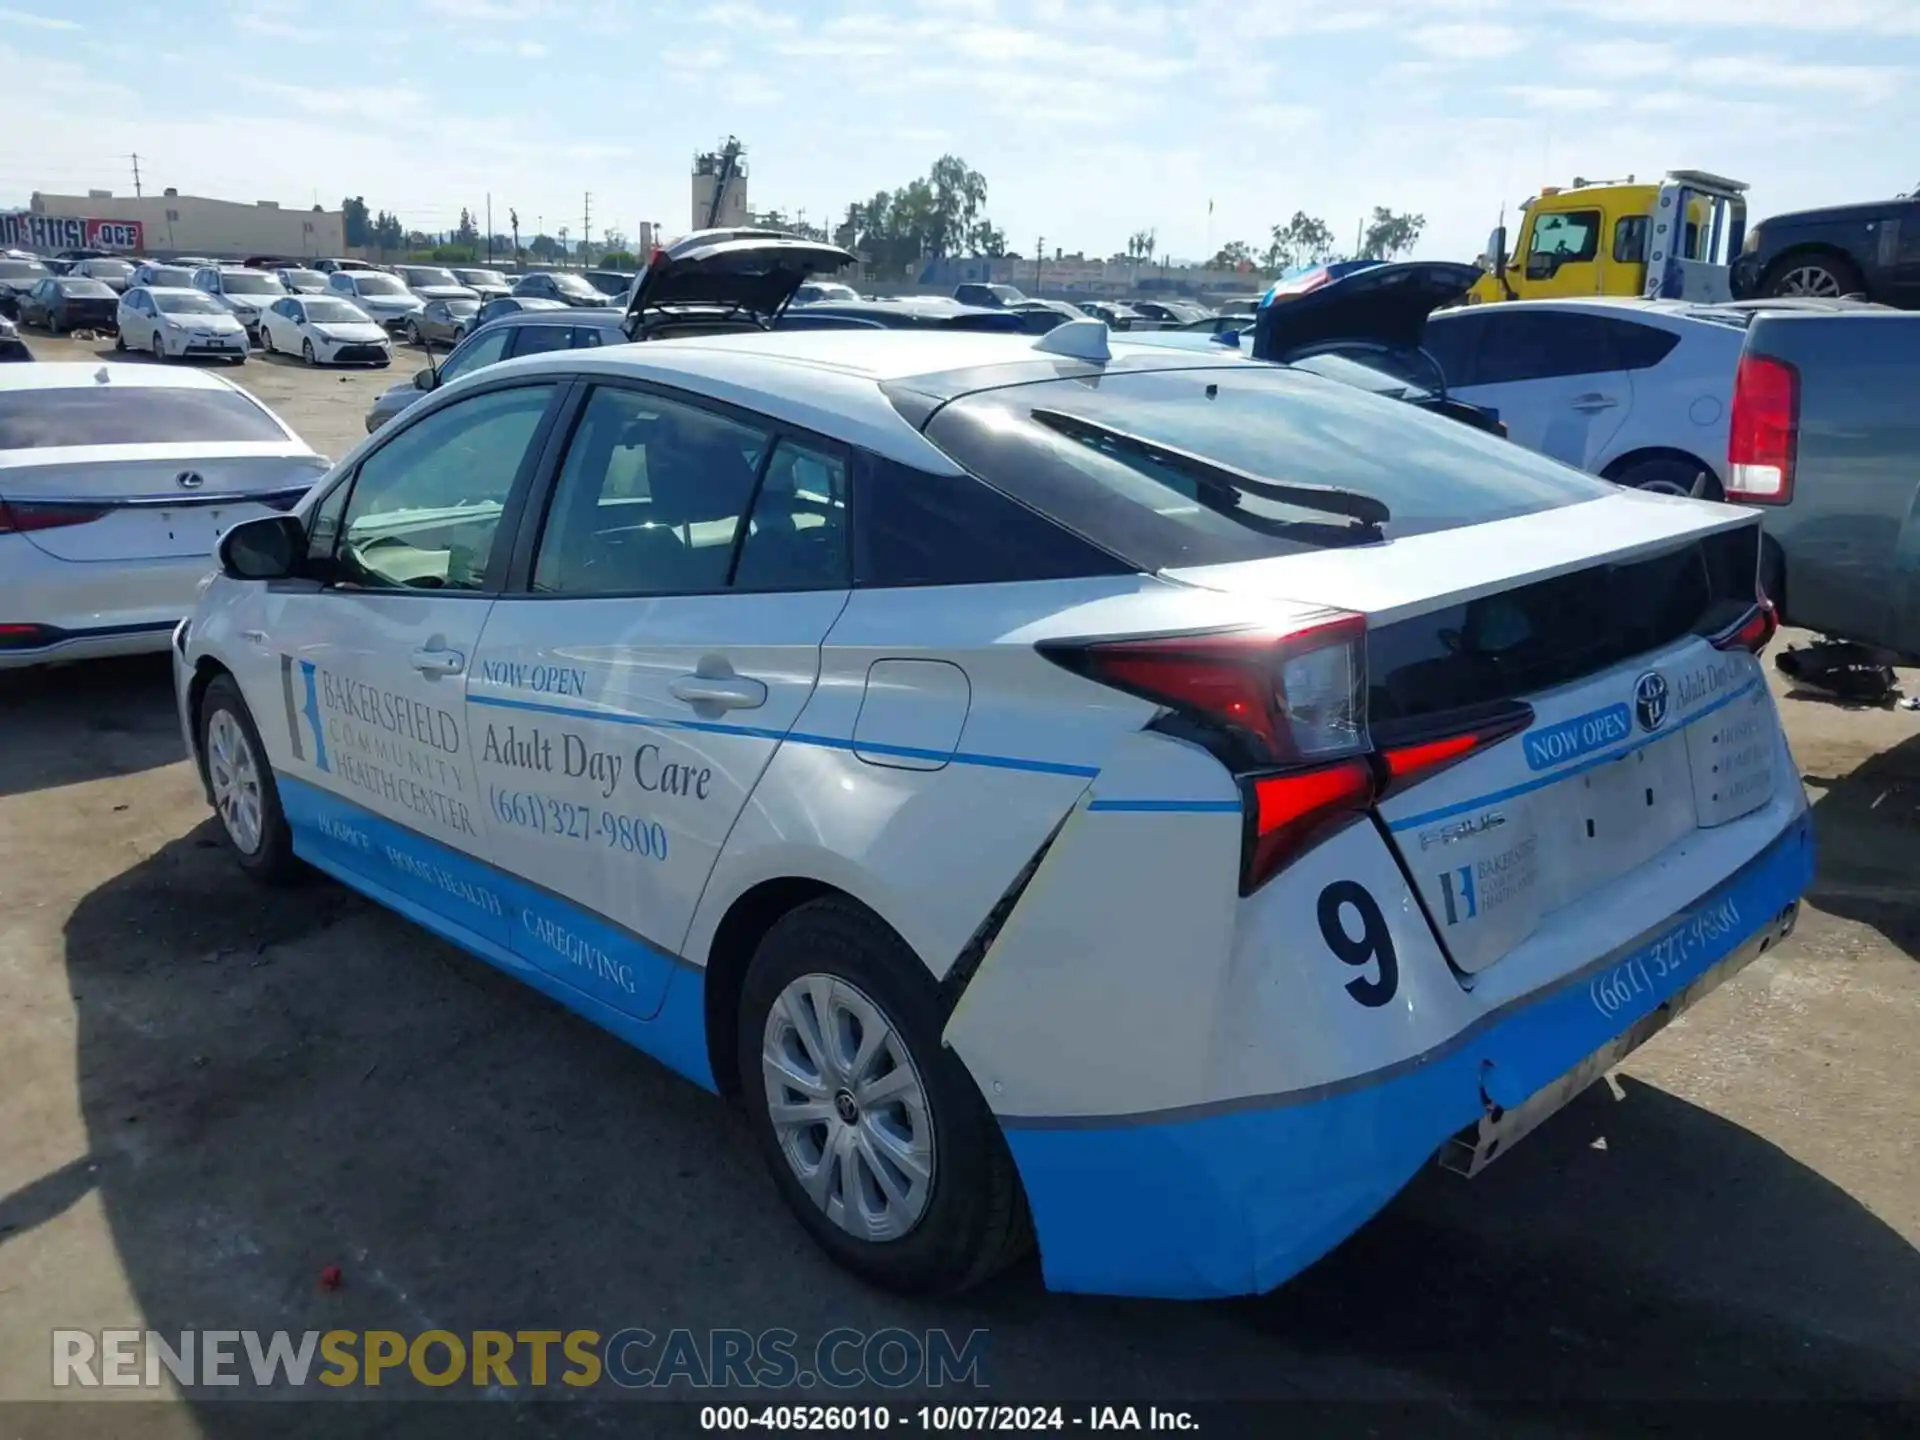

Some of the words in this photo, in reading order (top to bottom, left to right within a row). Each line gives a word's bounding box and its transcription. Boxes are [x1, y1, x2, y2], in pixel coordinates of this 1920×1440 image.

[322, 670, 460, 754] BAKERSFIELD
[482, 660, 531, 687] NOW
[532, 664, 586, 696] OPEN
[329, 716, 463, 792] COMMUNITY
[482, 722, 553, 774] Adult
[563, 732, 623, 800] Day
[633, 744, 712, 800] Care
[1530, 729, 1579, 765] NOW
[1582, 710, 1627, 746] OPEN
[521, 907, 637, 995] CAREGIVING
[1316, 879, 1399, 1008] 9
[1590, 957, 1655, 1019] (661)
